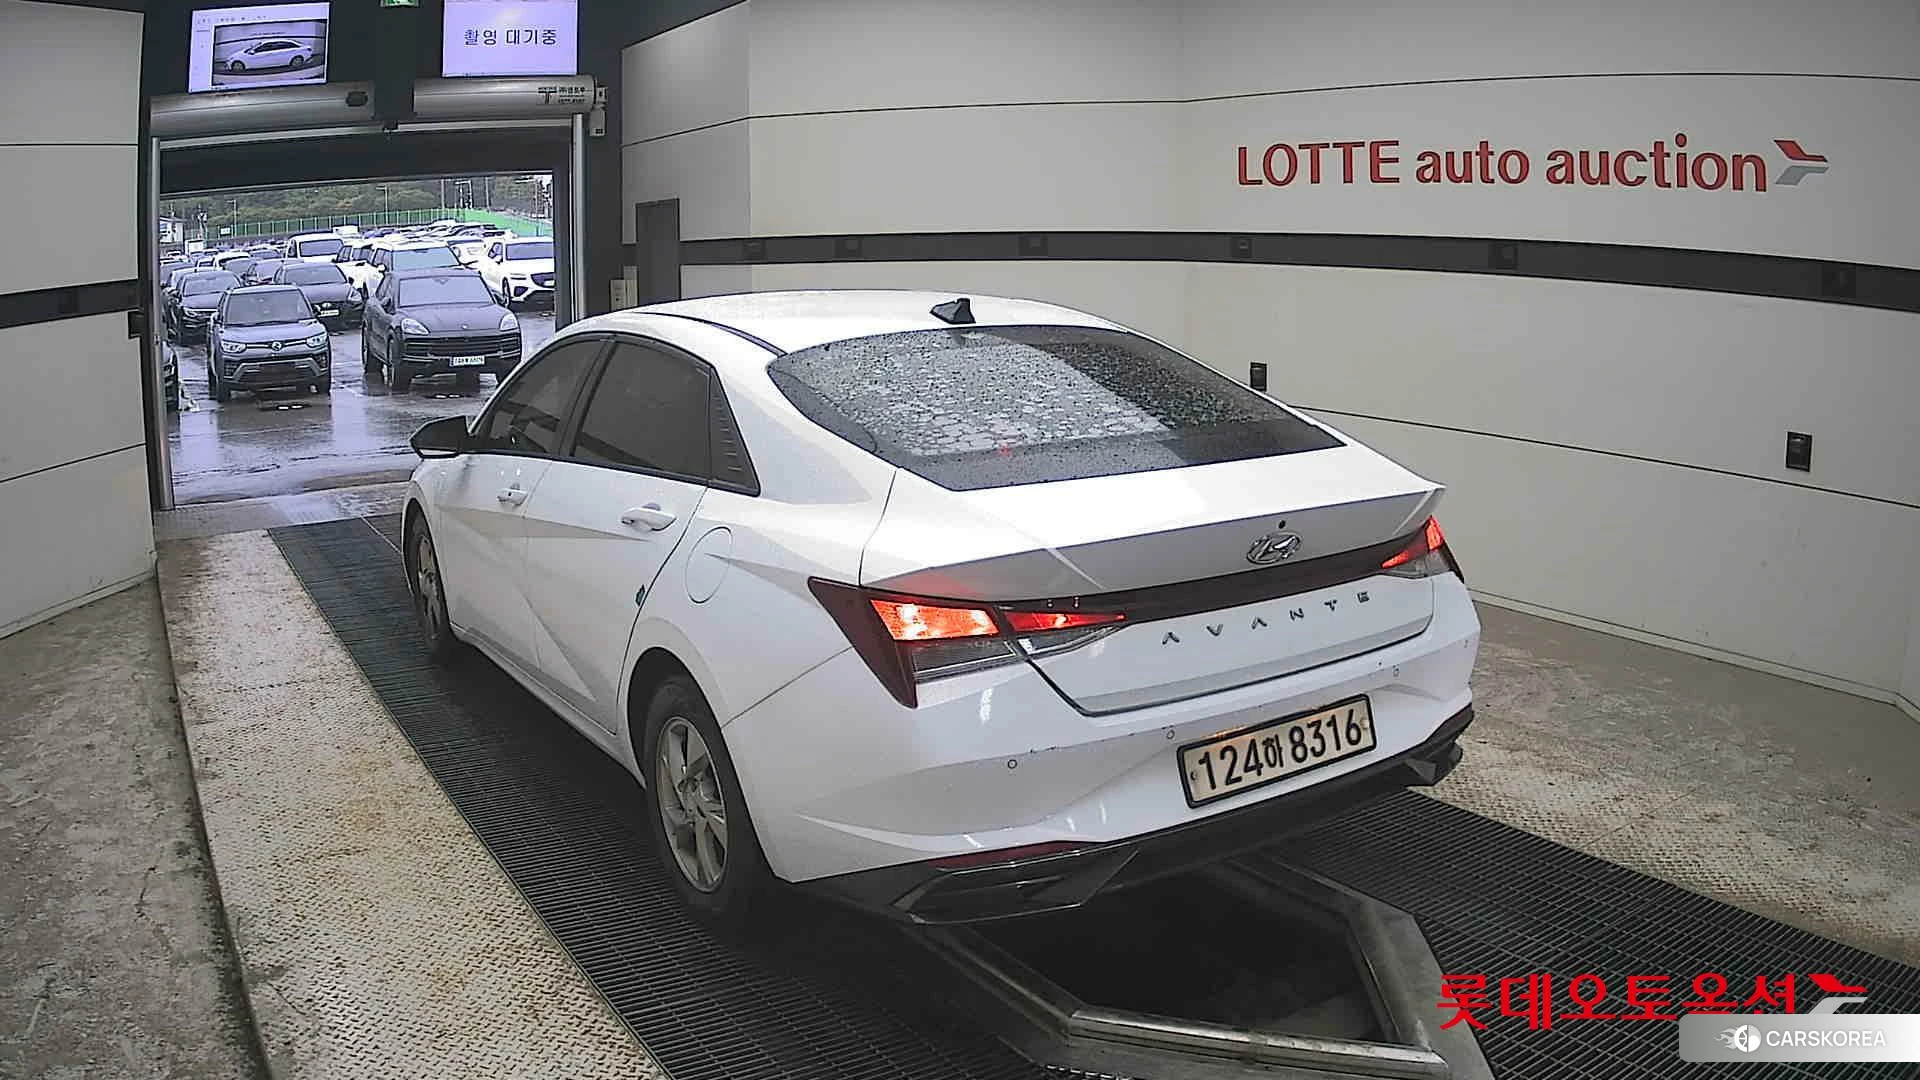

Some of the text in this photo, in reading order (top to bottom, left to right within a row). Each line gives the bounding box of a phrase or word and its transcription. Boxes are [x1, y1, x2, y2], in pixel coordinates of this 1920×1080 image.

[505, 29, 557, 46] 대기중
[1237, 133, 1768, 192] LOTTE auto auction
[1161, 590, 1370, 647] AVANTE
